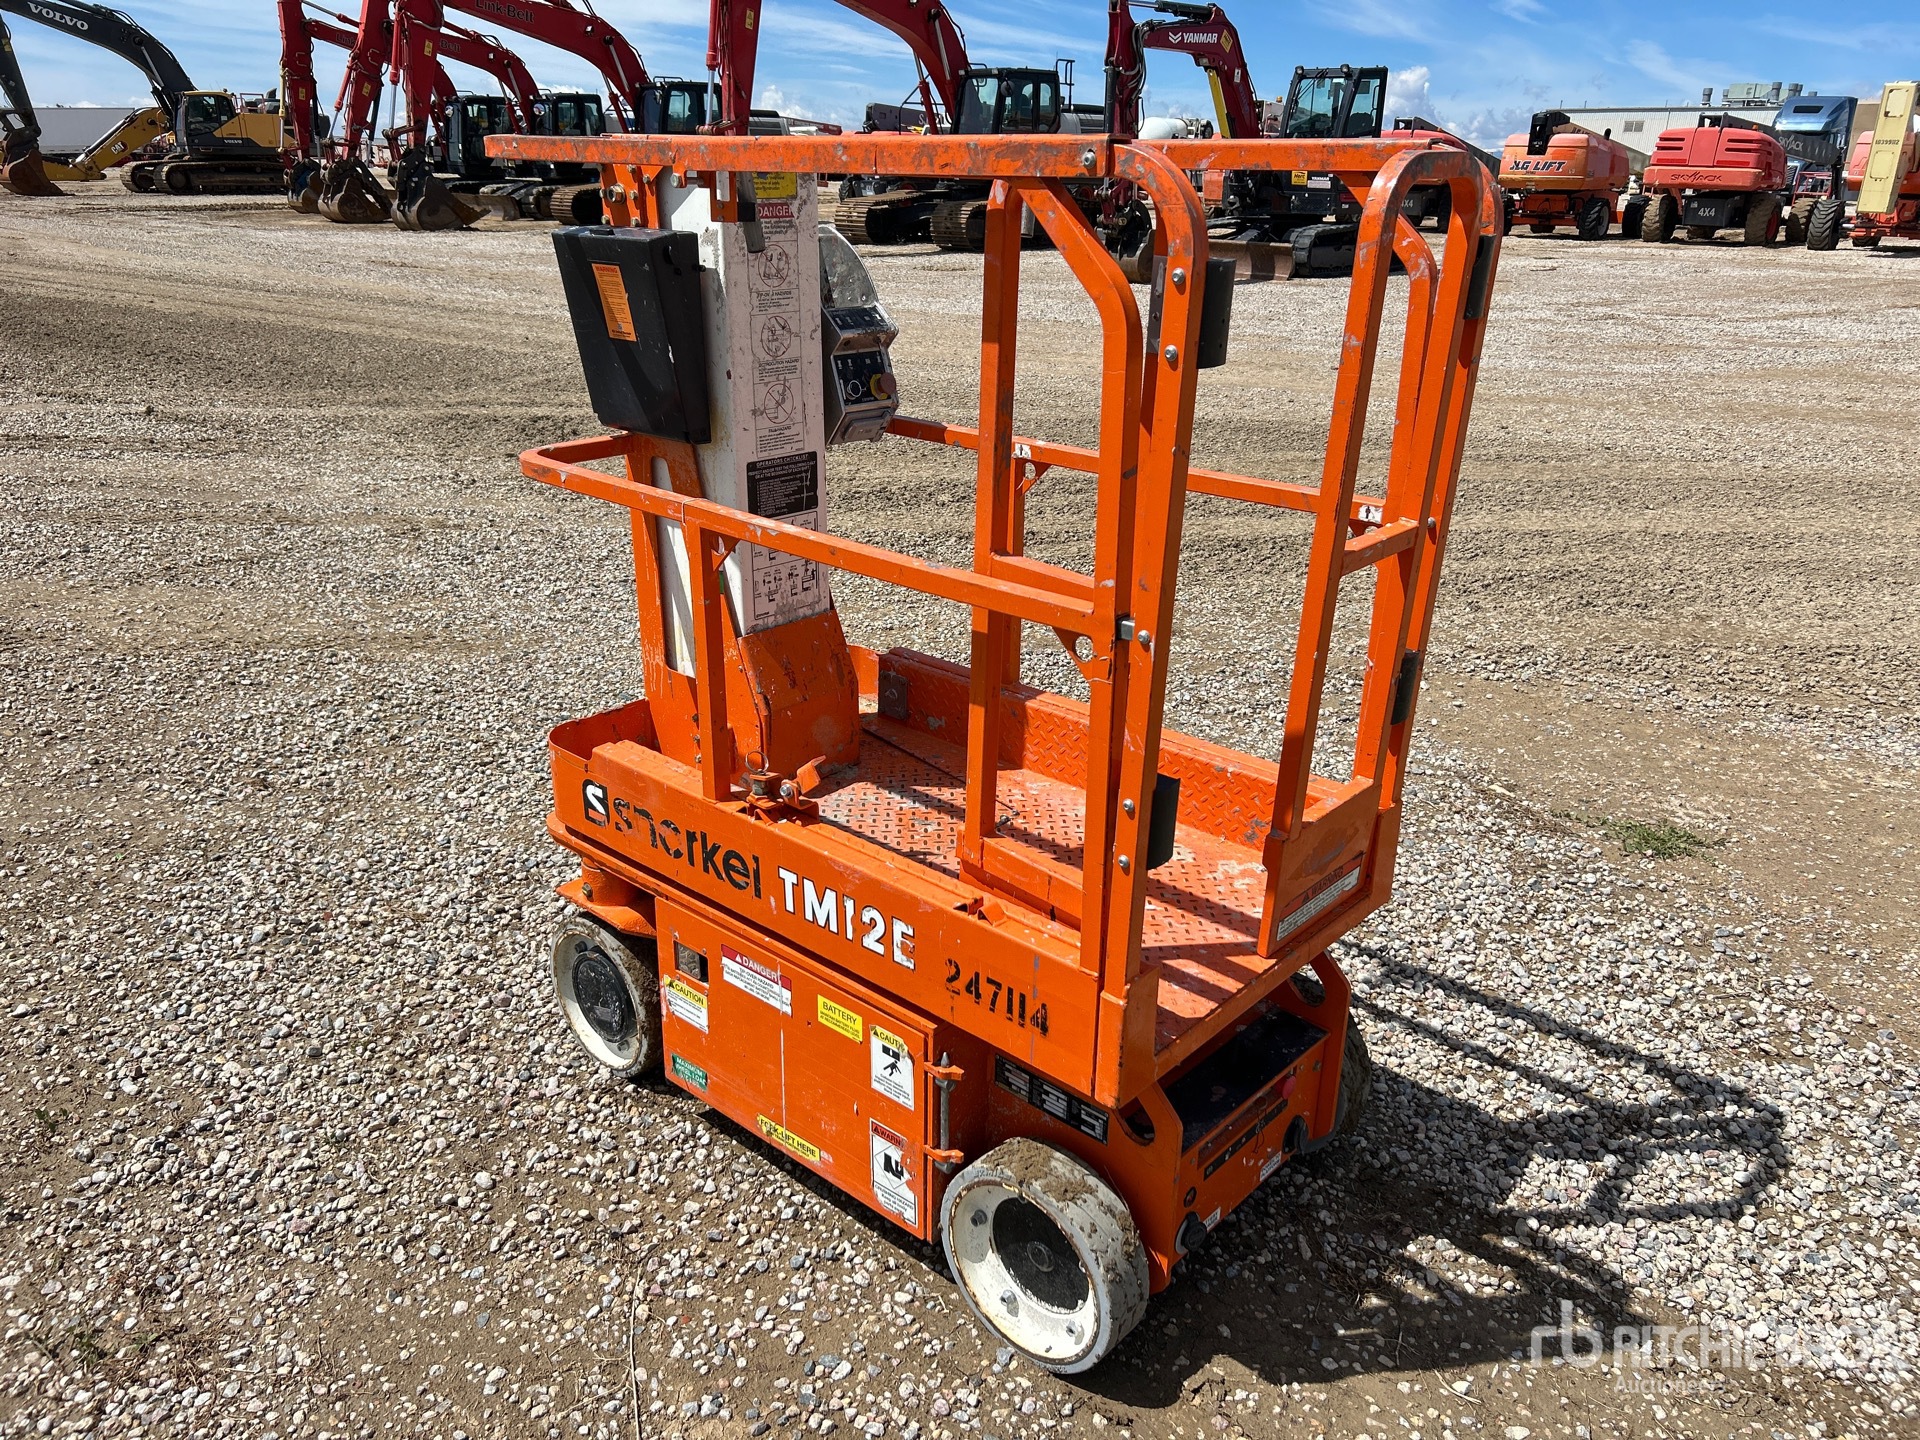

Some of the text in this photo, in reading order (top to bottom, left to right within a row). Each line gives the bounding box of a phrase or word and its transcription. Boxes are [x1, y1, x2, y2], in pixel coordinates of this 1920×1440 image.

[27, 1, 89, 31] VOLVO
[475, 0, 535, 23] Link-Belt
[1183, 32, 1218, 43] YANMAR
[110, 141, 125, 155] CAT
[1532, 160, 1567, 171] LIFT
[1671, 171, 1722, 182] SKYJACK
[1698, 207, 1716, 217] 4X4
[756, 454, 809, 467] OPERATORS CHECKLIST
[613, 797, 762, 900] snorkel
[778, 865, 915, 971] TM12E
[742, 955, 778, 983] DANGER
[674, 983, 704, 1006] CAUTION
[822, 1001, 857, 1026] BATTERY
[796, 1140, 817, 1157] HERE
